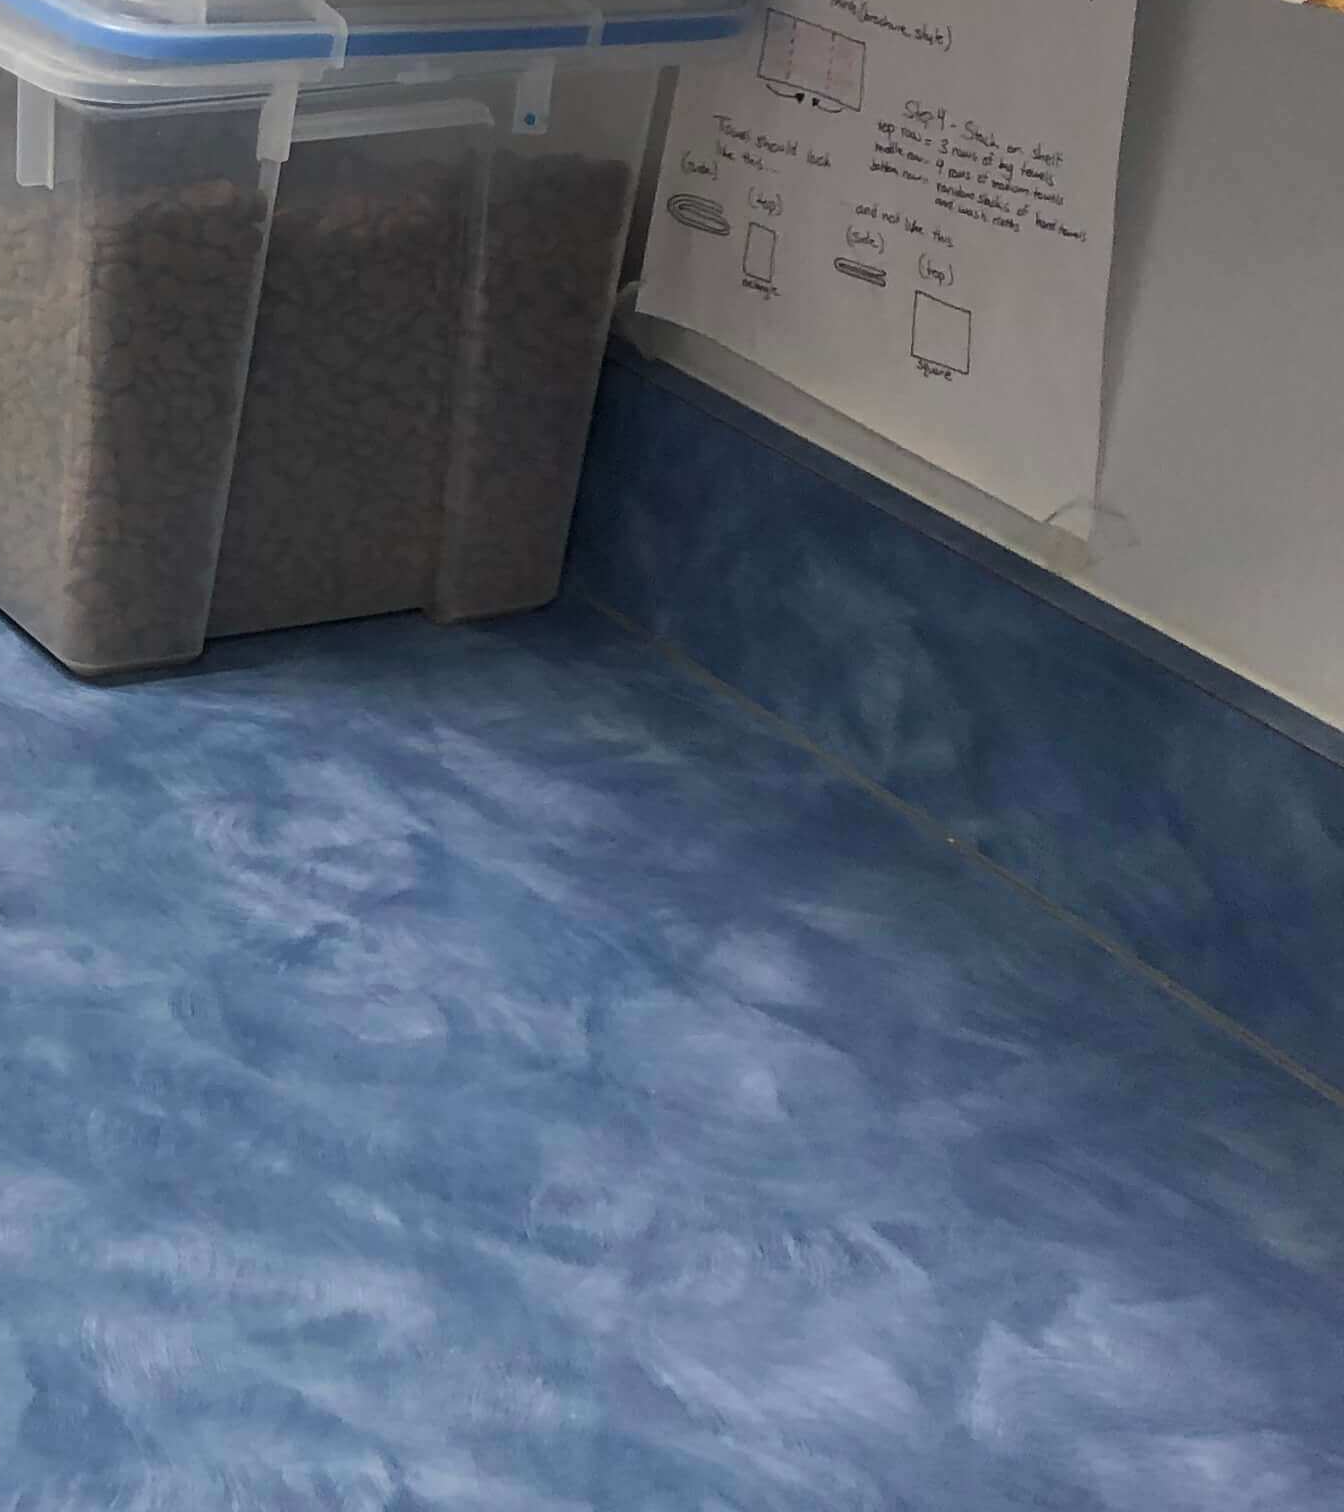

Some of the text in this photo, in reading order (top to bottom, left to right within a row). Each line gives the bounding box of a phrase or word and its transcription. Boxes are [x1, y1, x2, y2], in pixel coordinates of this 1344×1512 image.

[903, 99, 934, 130] Step
[938, 138, 949, 155] 3
[855, 204, 878, 219] and
[881, 210, 901, 224] not
[918, 252, 954, 287] (top)
[916, 358, 954, 382] square
